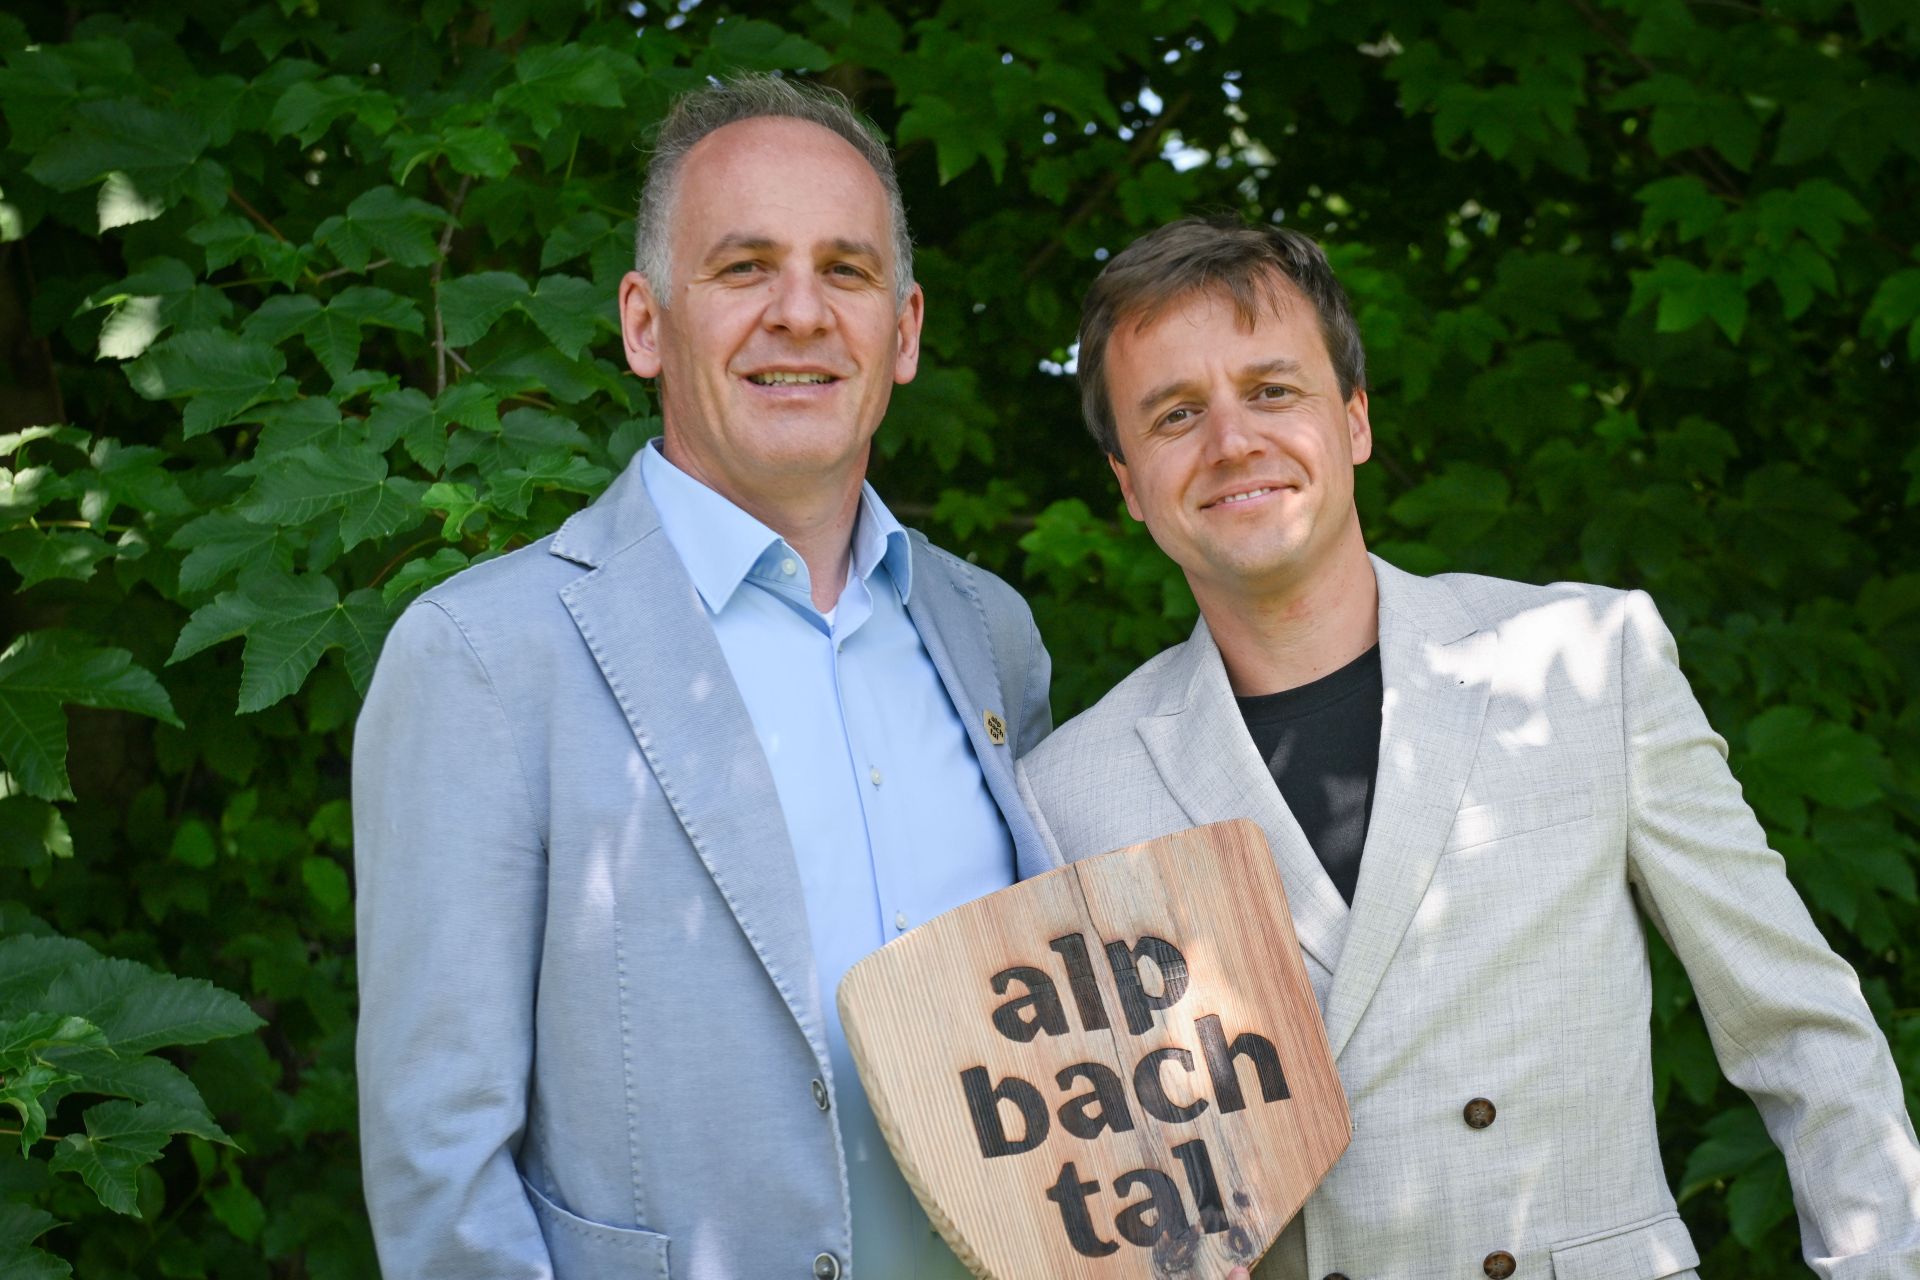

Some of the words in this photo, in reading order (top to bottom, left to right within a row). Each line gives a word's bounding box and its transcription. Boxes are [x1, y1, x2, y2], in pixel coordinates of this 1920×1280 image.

[989, 932, 1189, 1043] alp
[959, 1013, 1292, 1159] bach
[1045, 1138, 1231, 1259] tal
